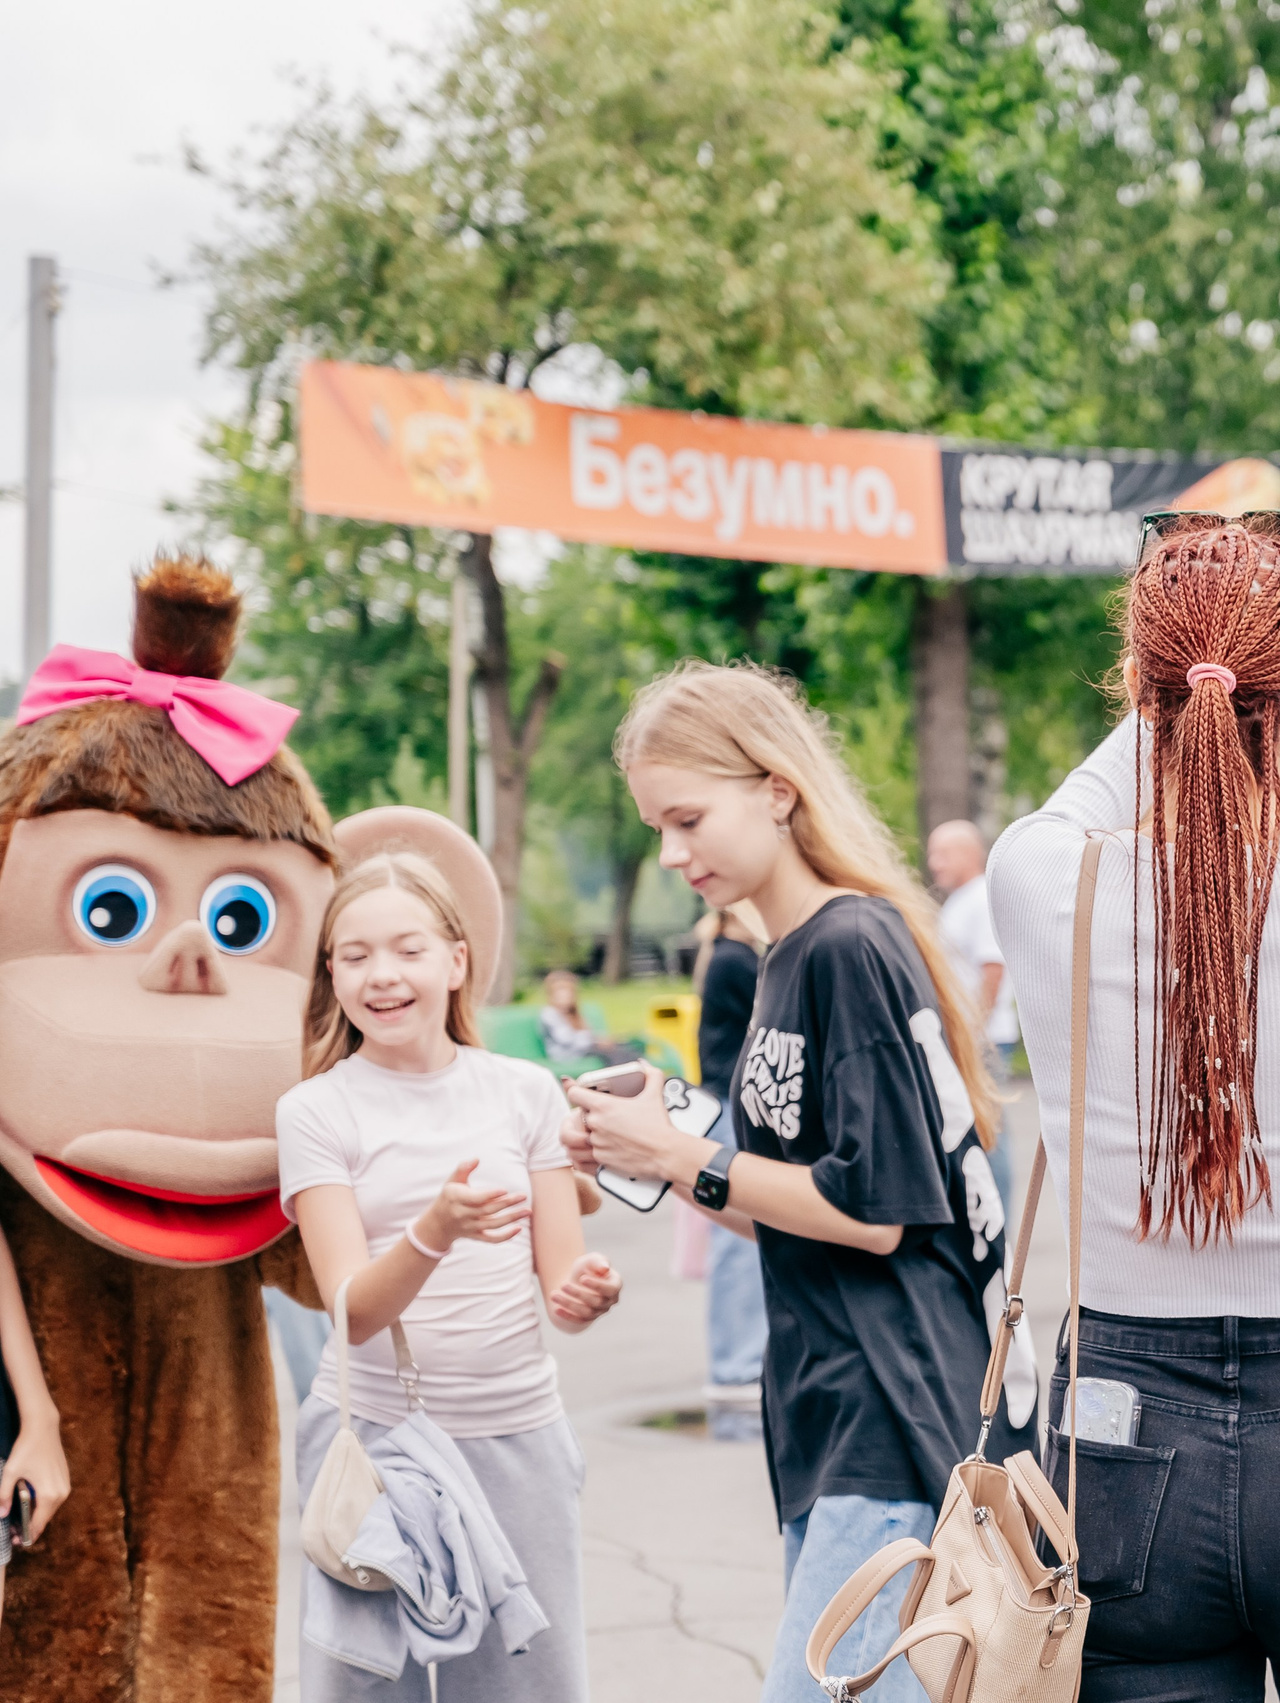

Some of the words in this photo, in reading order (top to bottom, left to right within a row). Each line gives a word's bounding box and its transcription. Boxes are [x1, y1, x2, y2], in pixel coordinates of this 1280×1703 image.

[568, 412, 915, 544] Безумно.
[961, 455, 1114, 511] КРУТАЯ
[747, 1026, 805, 1081] LOVE
